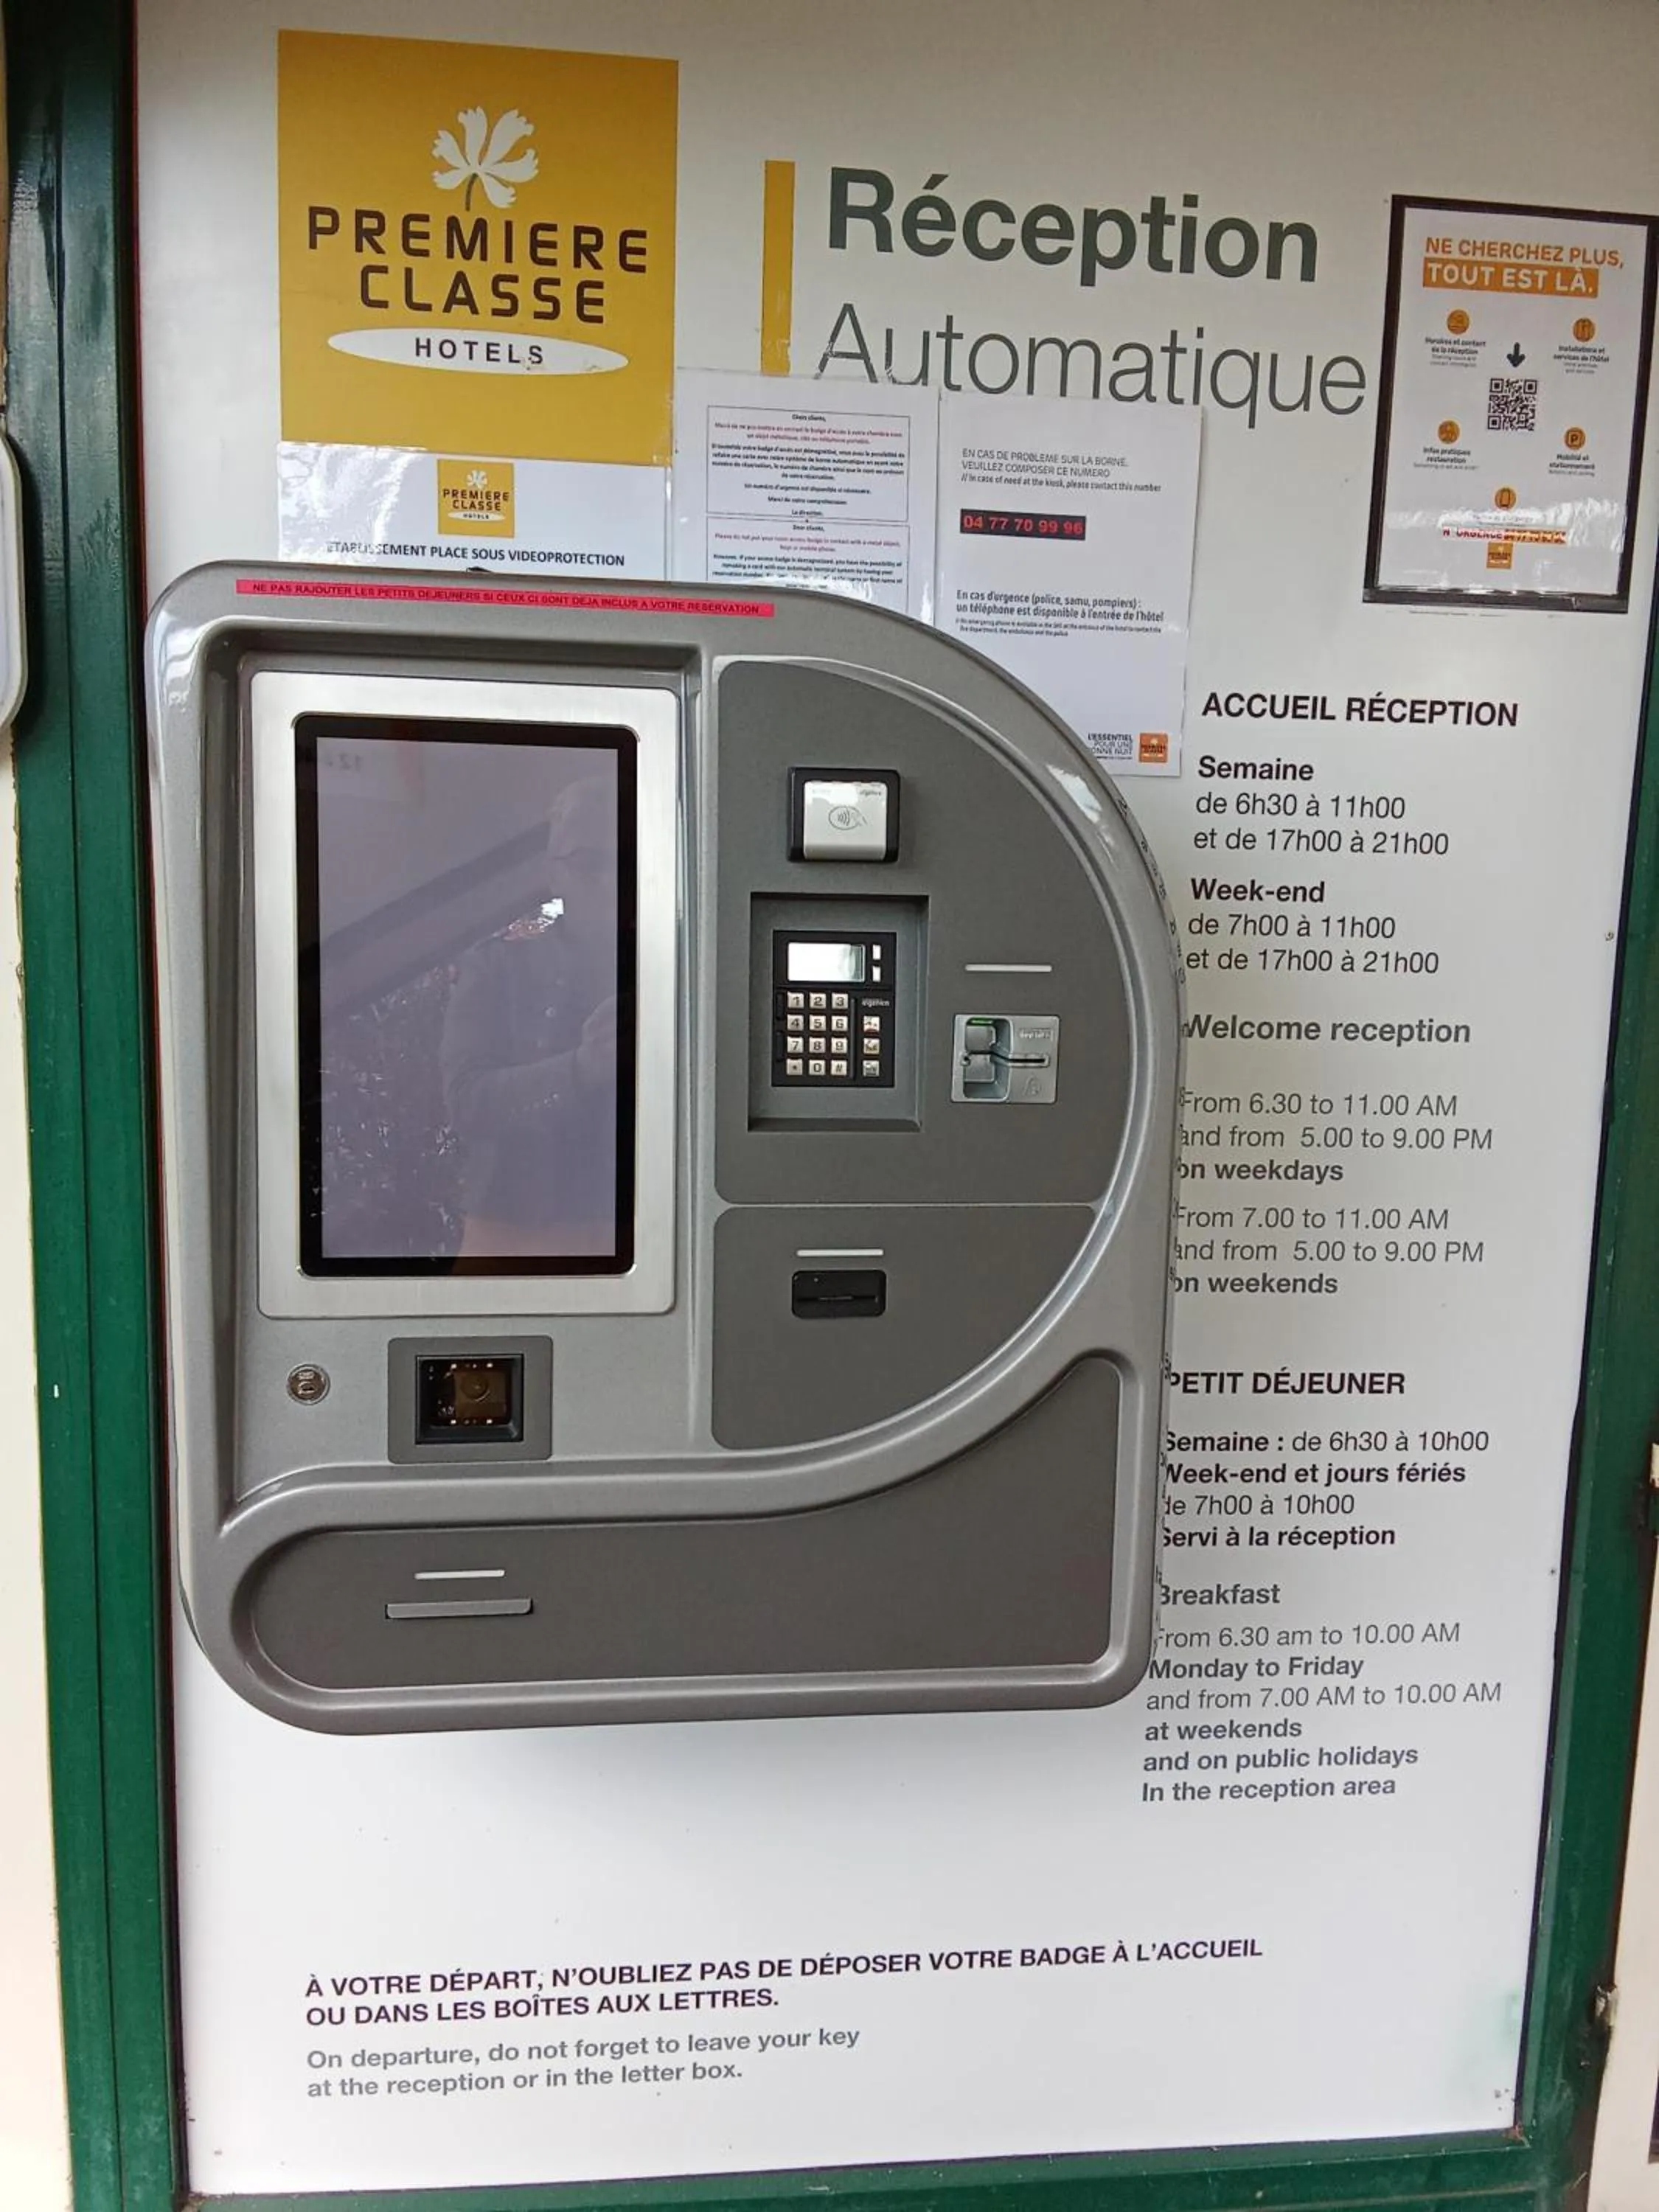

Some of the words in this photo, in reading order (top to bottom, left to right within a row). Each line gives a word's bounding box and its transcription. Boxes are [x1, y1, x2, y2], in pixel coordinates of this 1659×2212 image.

[830, 167, 1317, 282] Réception
[309, 206, 647, 273] PREMIERE
[1426, 237, 1453, 254] NE
[1459, 240, 1563, 262] CHERCHEZ
[1570, 247, 1624, 268] PLUS,
[1427, 262, 1495, 285] TOUT
[1502, 268, 1547, 289] EST
[1556, 265, 1593, 293] LÀ.
[361, 265, 604, 324] CLASSE
[416, 338, 543, 364] HOTELS
[814, 303, 1366, 429] Automatique
[961, 461, 1003, 471] VEUILLEZ
[1005, 464, 1054, 474] COMPOSER
[1057, 467, 1068, 476] CE
[1071, 467, 1110, 478] NUMERO
[963, 448, 975, 458] EN
[977, 450, 995, 459] CAS
[997, 451, 1008, 460] DE
[1011, 452, 1058, 462] PROBLEME
[1062, 455, 1079, 464] SUR
[1082, 456, 1093, 465] LA
[443, 489, 509, 501] PREMIERE
[453, 500, 501, 510] CLASSE
[964, 515, 983, 528] 04
[989, 518, 1009, 529] 77
[1015, 518, 1032, 531] 70
[1038, 520, 1057, 532] 99
[431, 546, 467, 559] PLACE
[472, 549, 504, 560] SOUS
[509, 550, 624, 566] VIDEOPROTECTION
[253, 583, 267, 591] NE
[295, 585, 352, 595] RAJOUTER
[355, 588, 375, 596] LES
[378, 589, 415, 599] PETITS
[417, 591, 479, 601] DEJEUNERS
[483, 593, 493, 601] SI
[496, 593, 524, 602] CEUX
[528, 594, 538, 603] CI
[542, 595, 568, 605] SONT
[573, 597, 599, 607] DEJA
[602, 597, 638, 608] INCLUS
[641, 600, 648, 608] A
[651, 600, 684, 611] VOTRE
[688, 602, 759, 613] RESERVATION
[957, 590, 968, 599] En
[970, 592, 984, 600] cas
[987, 591, 1029, 603] d'urgence
[1032, 594, 1062, 605] (police,
[1065, 597, 1091, 606] samu,
[1093, 597, 1136, 609] pompiers)
[957, 604, 967, 612] un
[970, 603, 1015, 615] téléphone
[1018, 607, 1031, 615] est
[1033, 607, 1079, 619] disponible
[1081, 608, 1086, 618] à
[1088, 609, 1121, 619] l'entrée
[1124, 611, 1134, 619] de
[1136, 611, 1164, 621] l'hôtel
[1202, 692, 1335, 720] ACCUEIL
[1346, 692, 1517, 726] RÉCEPTION
[1198, 755, 1313, 780] Semaine
[1196, 792, 1227, 814] de
[1237, 793, 1297, 815] 6h30
[1306, 794, 1319, 816] à
[1332, 796, 1405, 818] 11h00
[1192, 878, 1324, 902] Week-end
[1189, 913, 1219, 935] de
[1228, 914, 1288, 936] 7h00
[1297, 915, 1310, 936] à
[1322, 917, 1395, 938] 11h00
[793, 996, 800, 1006] 1
[813, 996, 823, 1006] 2
[835, 996, 844, 1006] 3
[1187, 1014, 1321, 1040] Welcome
[1331, 1018, 1470, 1047] reception
[1215, 1159, 1343, 1185] weekdays
[1253, 1367, 1405, 1394] DÉJEUNER
[1295, 1464, 1318, 1483] et
[1324, 1463, 1388, 1486] jours
[1397, 1463, 1465, 1482] fériés
[1164, 1526, 1217, 1547] Servi
[1225, 1526, 1239, 1546] à
[1249, 1526, 1268, 1545] la
[1279, 1526, 1394, 1550] réception
[1161, 1584, 1281, 1605] Breakfast
[1149, 1658, 1248, 1682] Monday
[1256, 1658, 1279, 1677] to
[1289, 1656, 1363, 1678] Friday
[1147, 1690, 1189, 1710] and
[1199, 1689, 1251, 1708] from
[1261, 1687, 1309, 1707] 7.00
[1317, 1686, 1354, 1705] AM
[1363, 1687, 1385, 1705] to
[1395, 1683, 1455, 1703] 10.00
[1463, 1683, 1501, 1702] AM
[1145, 1722, 1169, 1741] at
[1177, 1718, 1301, 1739] weekends
[1144, 1751, 1189, 1771] and
[1197, 1755, 1227, 1770] on
[1237, 1748, 1310, 1773] public
[1318, 1746, 1418, 1768] holidays
[1143, 1783, 1164, 1801] In
[1172, 1781, 1211, 1801] the
[1220, 1778, 1334, 1802] reception
[1343, 1780, 1395, 1795] area
[306, 1975, 323, 1997] À
[331, 1975, 420, 1996] VOTRE
[431, 1969, 543, 1992] DÉPART,
[553, 1964, 692, 1986] N'OUBLIEZ
[700, 1961, 750, 1980] PAS
[759, 1959, 792, 1978] DE
[801, 1952, 920, 1976] DÉPOSER
[929, 1950, 1012, 1970] VOTRE
[1020, 1946, 1105, 1966] BADGE
[1113, 1940, 1128, 1962] À
[1137, 1939, 1262, 1961] L'ACCUEIL
[307, 2007, 344, 2025] OU
[355, 2004, 428, 2023] DANS
[438, 2001, 485, 2020] LES
[495, 1995, 588, 2017] BOÎTES
[597, 1994, 650, 2013] AUX
[660, 1989, 778, 2010] LETTRES.
[308, 2080, 331, 2097] at
[339, 2078, 378, 2096] the
[388, 2073, 504, 2096] reception
[513, 2074, 538, 2088] or
[547, 2069, 566, 2087] in
[574, 2067, 613, 2084] the
[622, 2065, 684, 2082] letter
[693, 2062, 742, 2079] box.
